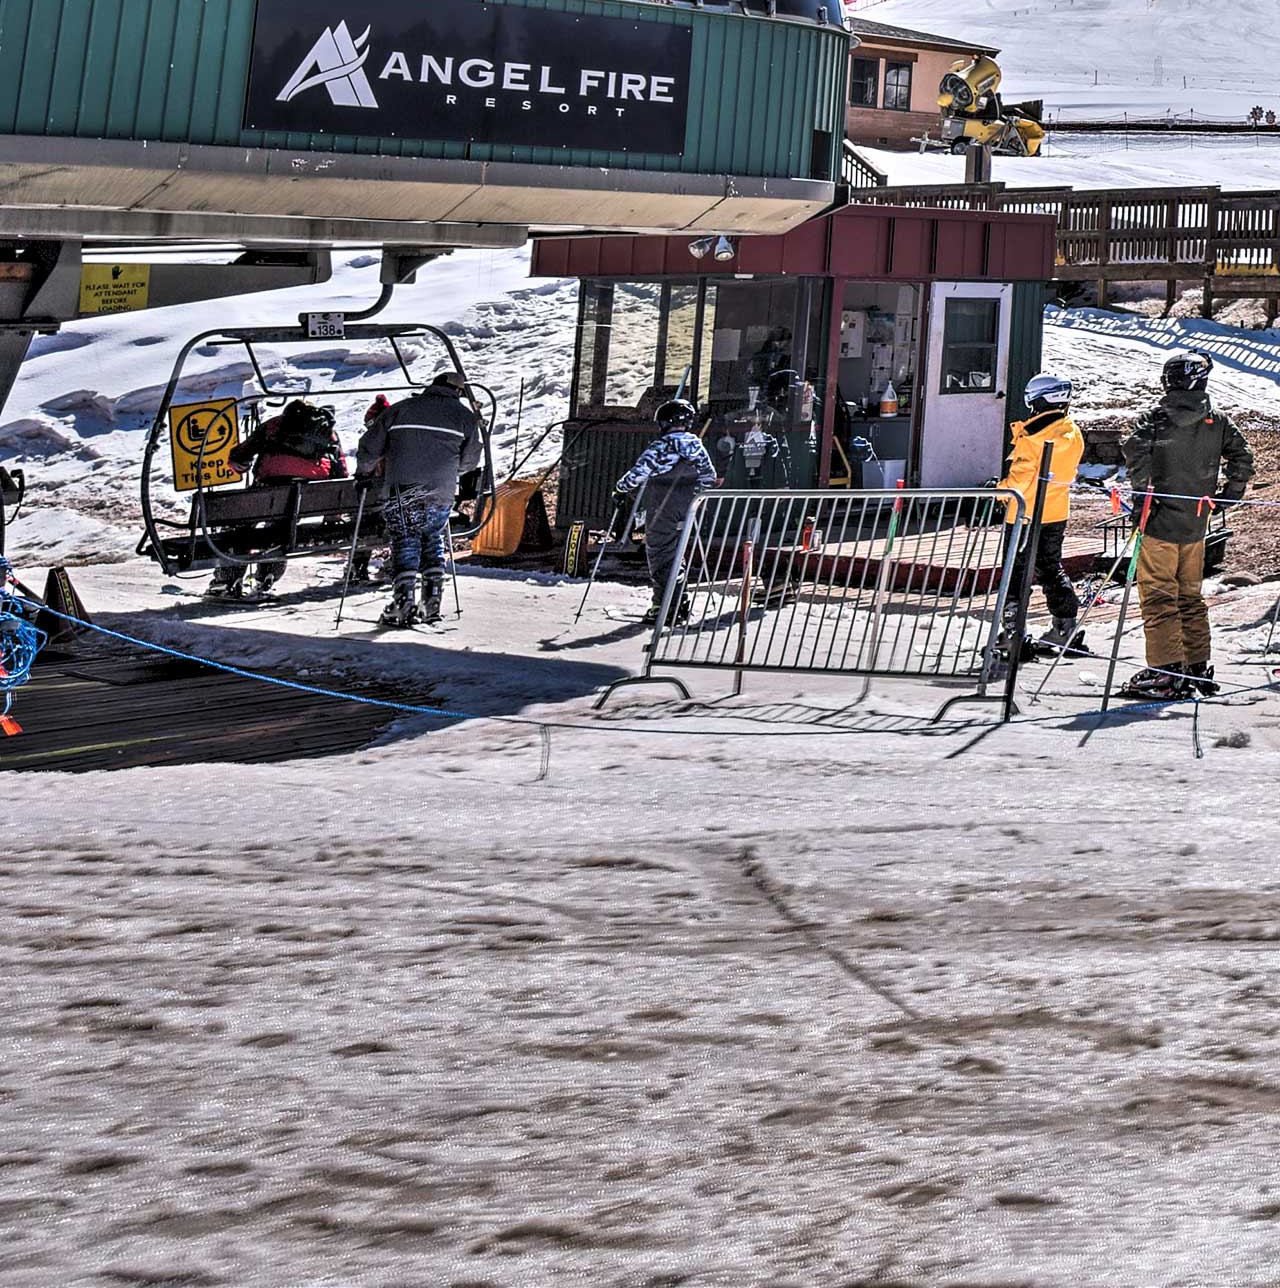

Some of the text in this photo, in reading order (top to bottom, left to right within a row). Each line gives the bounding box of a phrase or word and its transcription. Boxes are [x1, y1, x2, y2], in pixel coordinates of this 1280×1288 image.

[379, 51, 675, 103] ANGEL FIRE
[446, 95, 625, 117] RESORT
[85, 283, 109, 291] PLEASE
[93, 289, 137, 298] ATTENDANT
[317, 325, 335, 336] 138
[190, 459, 224, 470] Keep
[216, 468, 234, 479] Up
